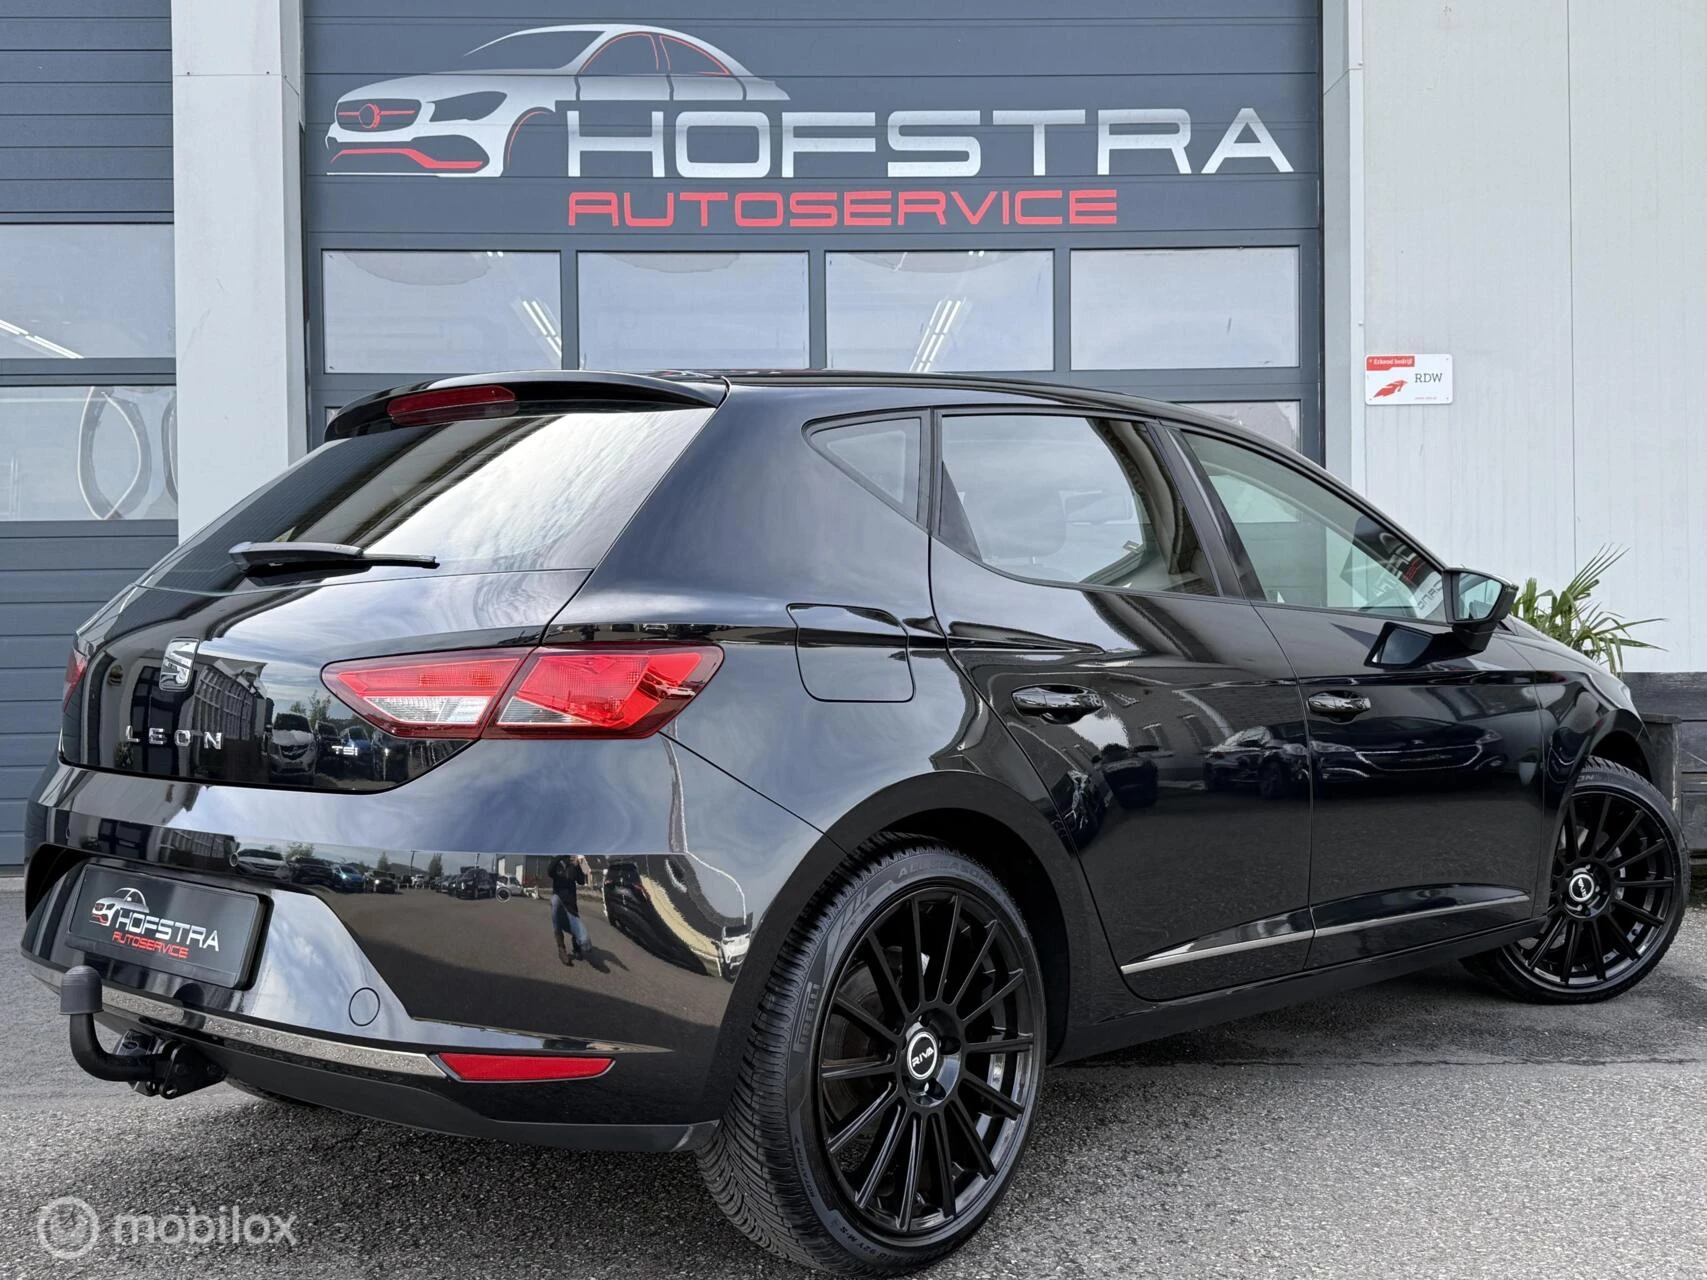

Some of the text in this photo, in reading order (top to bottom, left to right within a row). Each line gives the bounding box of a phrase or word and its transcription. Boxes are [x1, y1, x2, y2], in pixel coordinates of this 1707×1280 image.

[567, 107, 1295, 179] HOFSTRA
[568, 189, 1118, 228] AUTOSERVICE
[1414, 373, 1443, 383] RDW
[125, 725, 222, 750] LEON
[116, 908, 219, 952] HOFSTRA
[112, 931, 190, 960] AUTOSERVICE
[912, 1046, 934, 1068] RIVA
